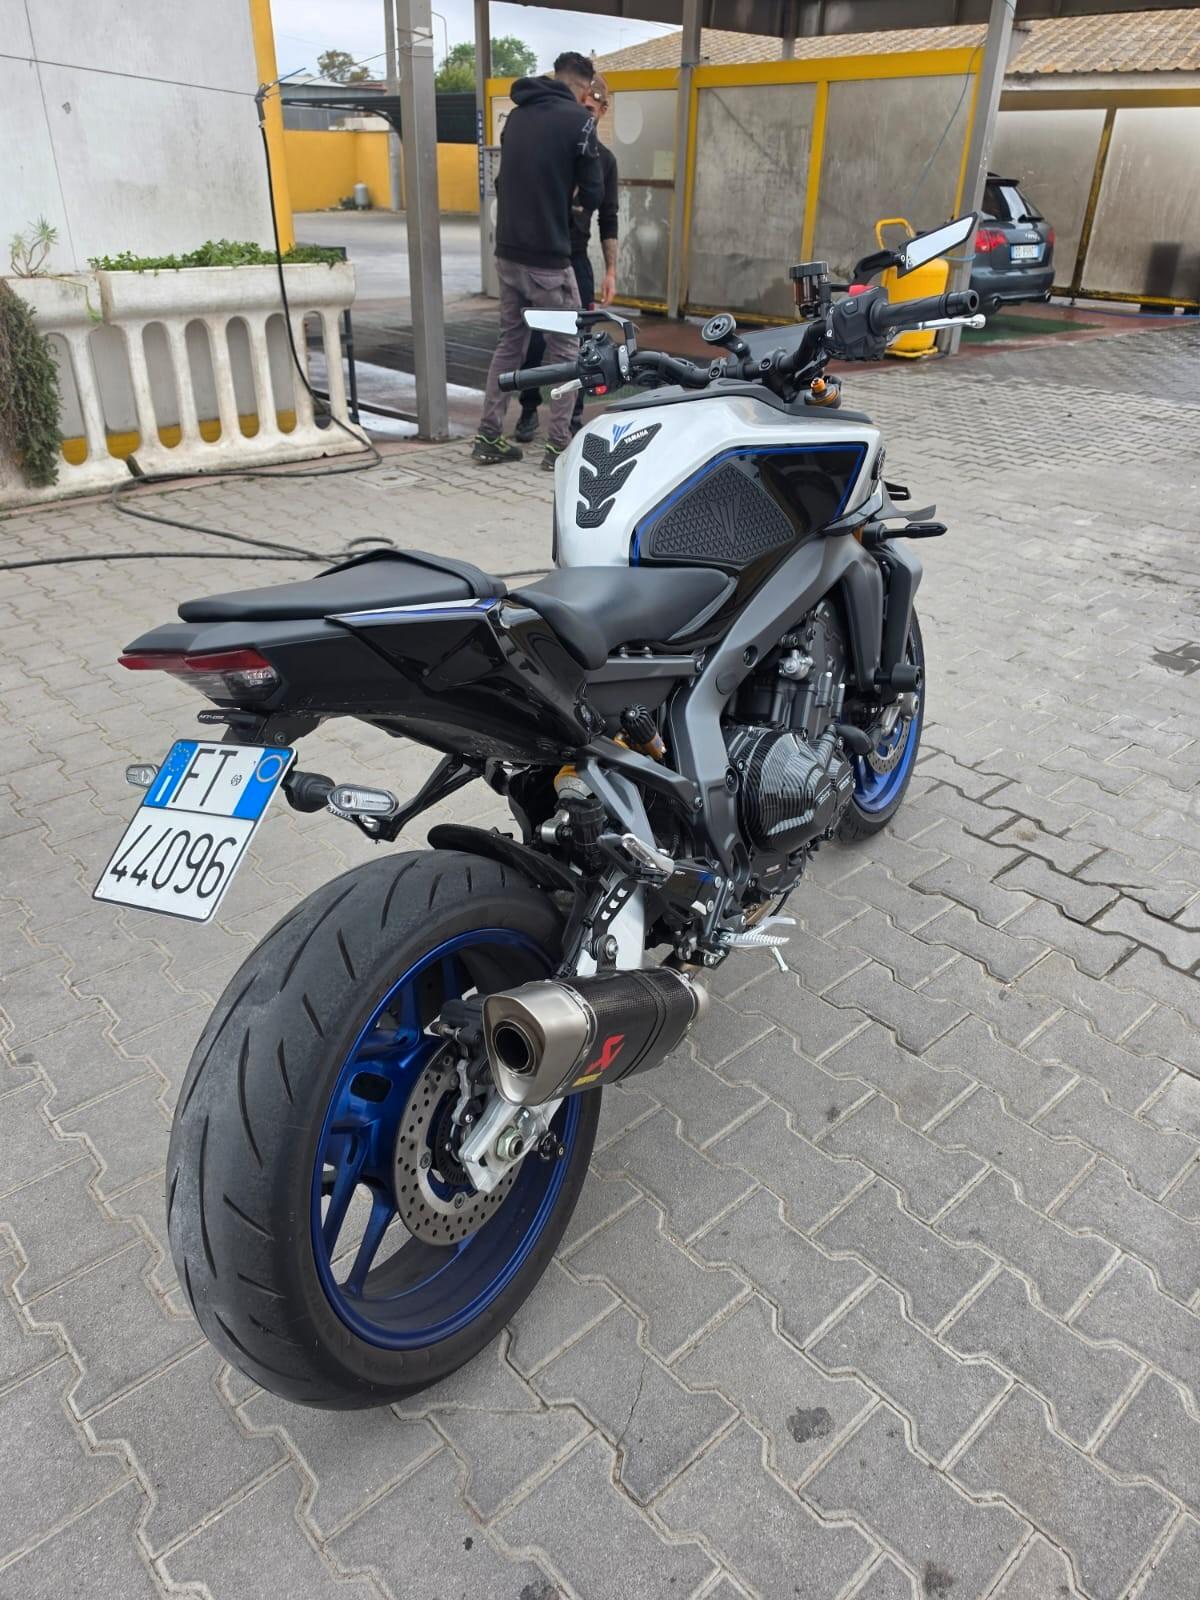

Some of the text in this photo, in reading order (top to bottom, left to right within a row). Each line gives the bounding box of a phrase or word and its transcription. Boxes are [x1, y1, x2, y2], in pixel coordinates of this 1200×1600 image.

[624, 429, 648, 444] YAMAHA
[155, 775, 172, 802] I
[172, 748, 238, 806] FT
[110, 824, 237, 898] 44096
